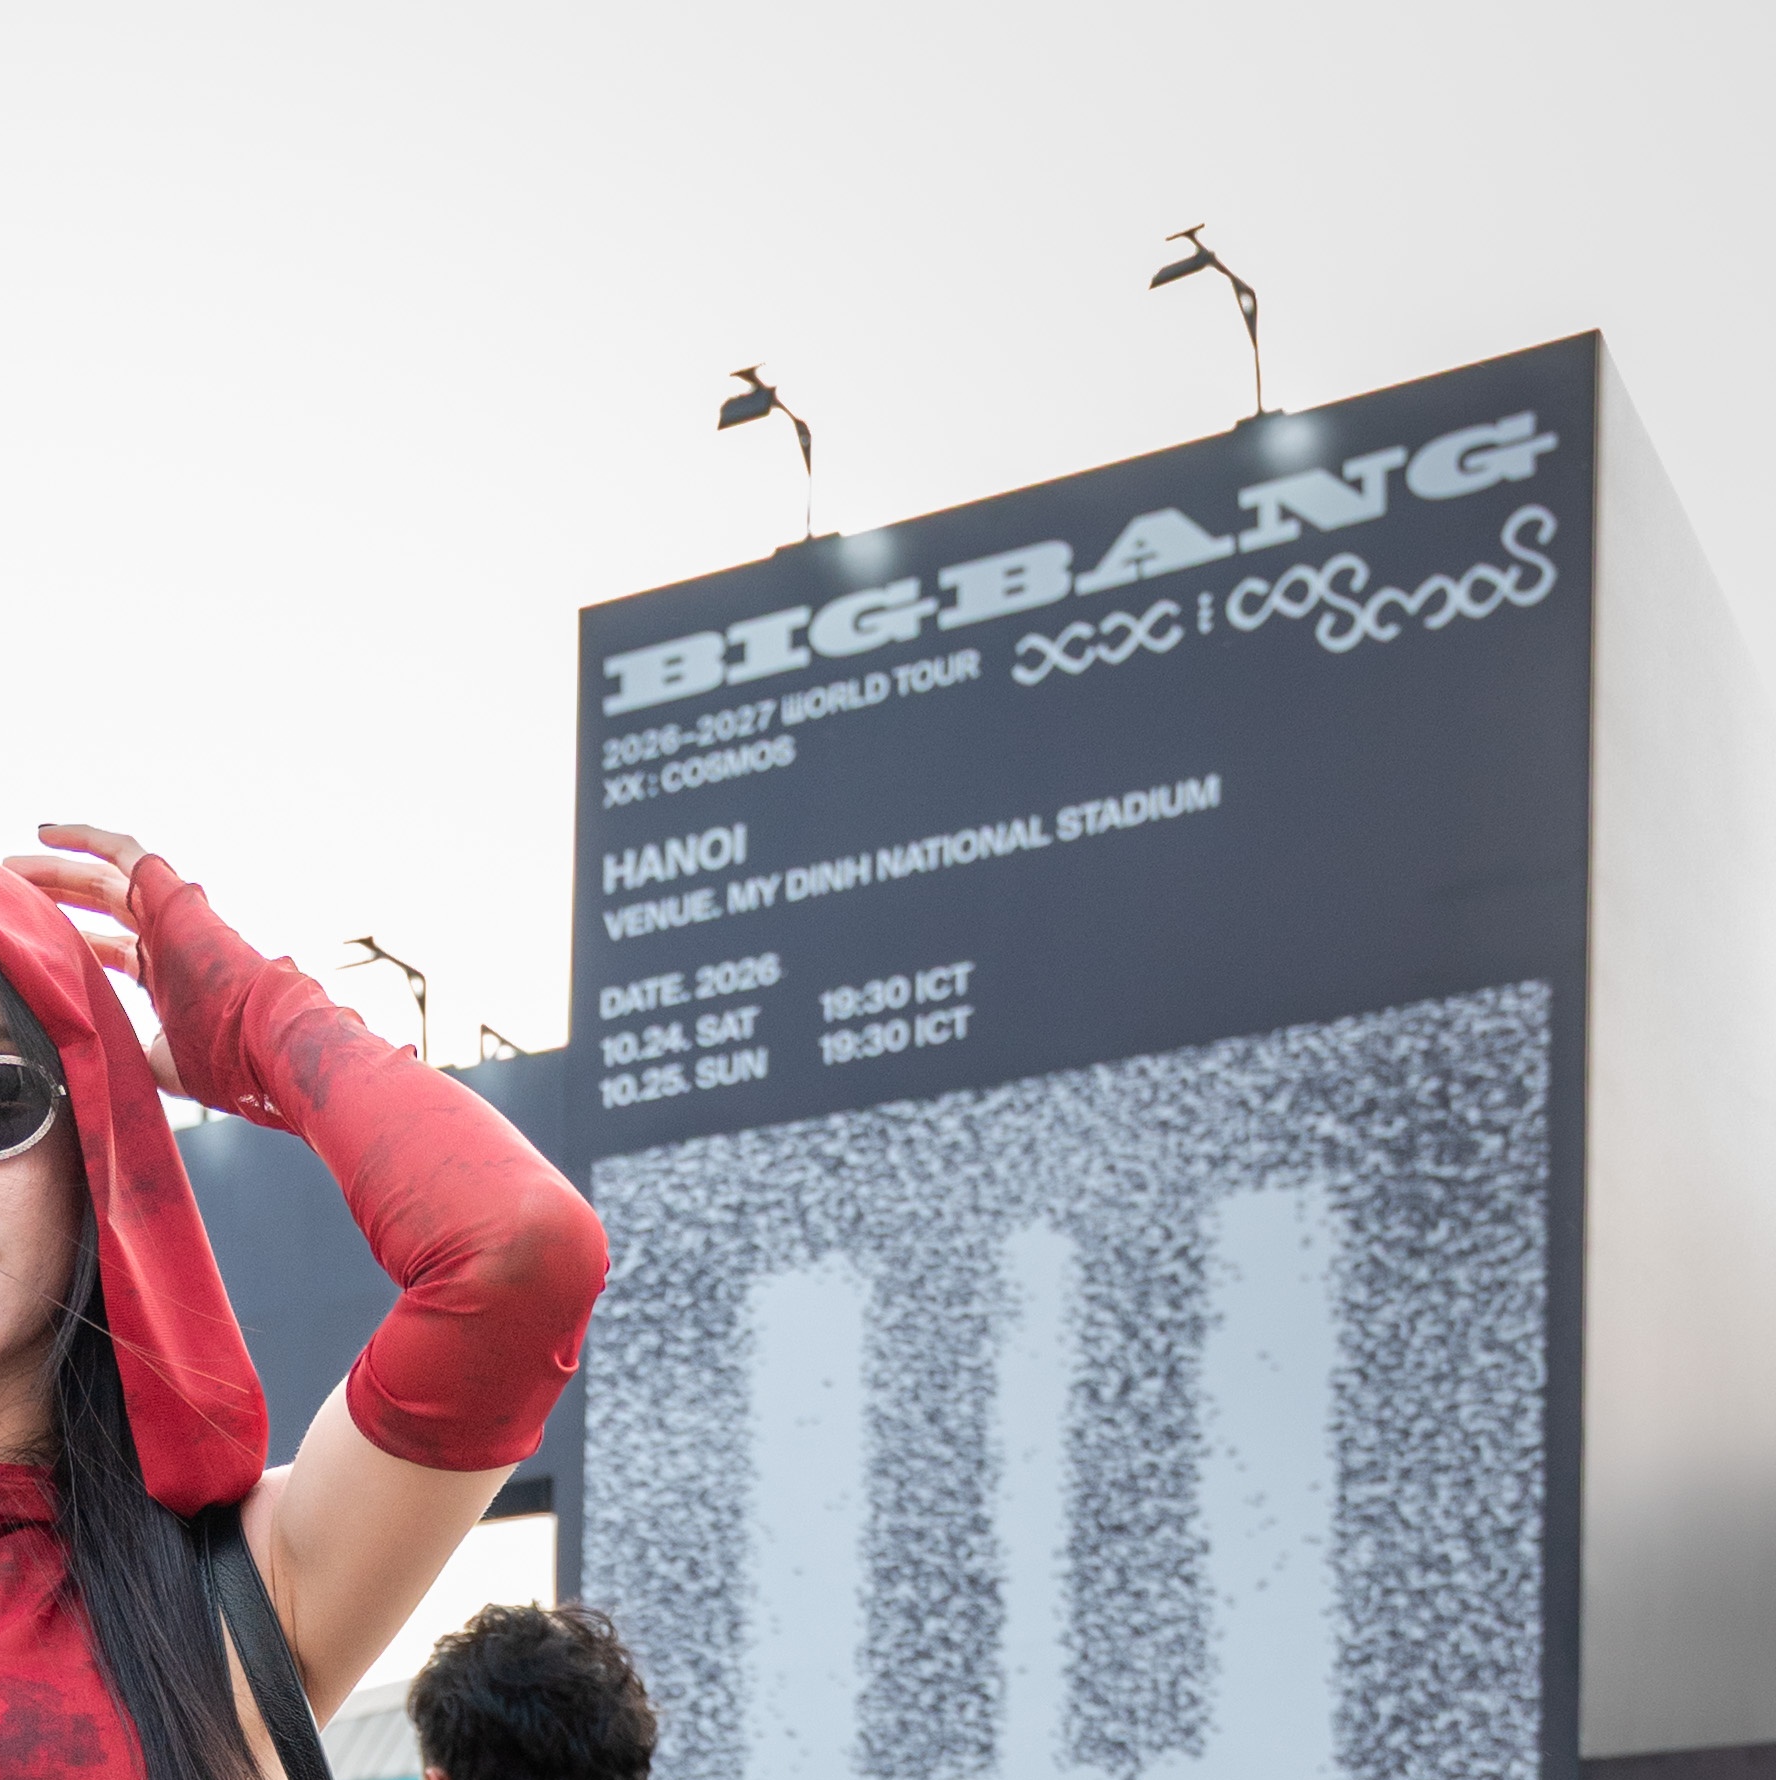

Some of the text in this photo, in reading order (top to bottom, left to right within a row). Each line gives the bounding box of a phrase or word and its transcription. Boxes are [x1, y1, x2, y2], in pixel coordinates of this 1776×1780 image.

[603, 411, 1558, 716] BIGBANG
[781, 673, 890, 726] WORLD
[895, 649, 982, 696] TOUR
[602, 823, 747, 893] HANOI
[727, 874, 782, 916] MY
[786, 854, 871, 901] DINH
[876, 816, 1053, 880] NATIONAL
[1056, 773, 1222, 844] STADIUM
[599, 952, 782, 1020] DATE. 2026
[695, 1005, 762, 1049] SAT
[820, 975, 911, 1022] 19:30
[915, 961, 976, 1004] ICT
[695, 1047, 770, 1090] SUN
[819, 1020, 911, 1065] 19:30
[915, 1004, 976, 1047] ICT
